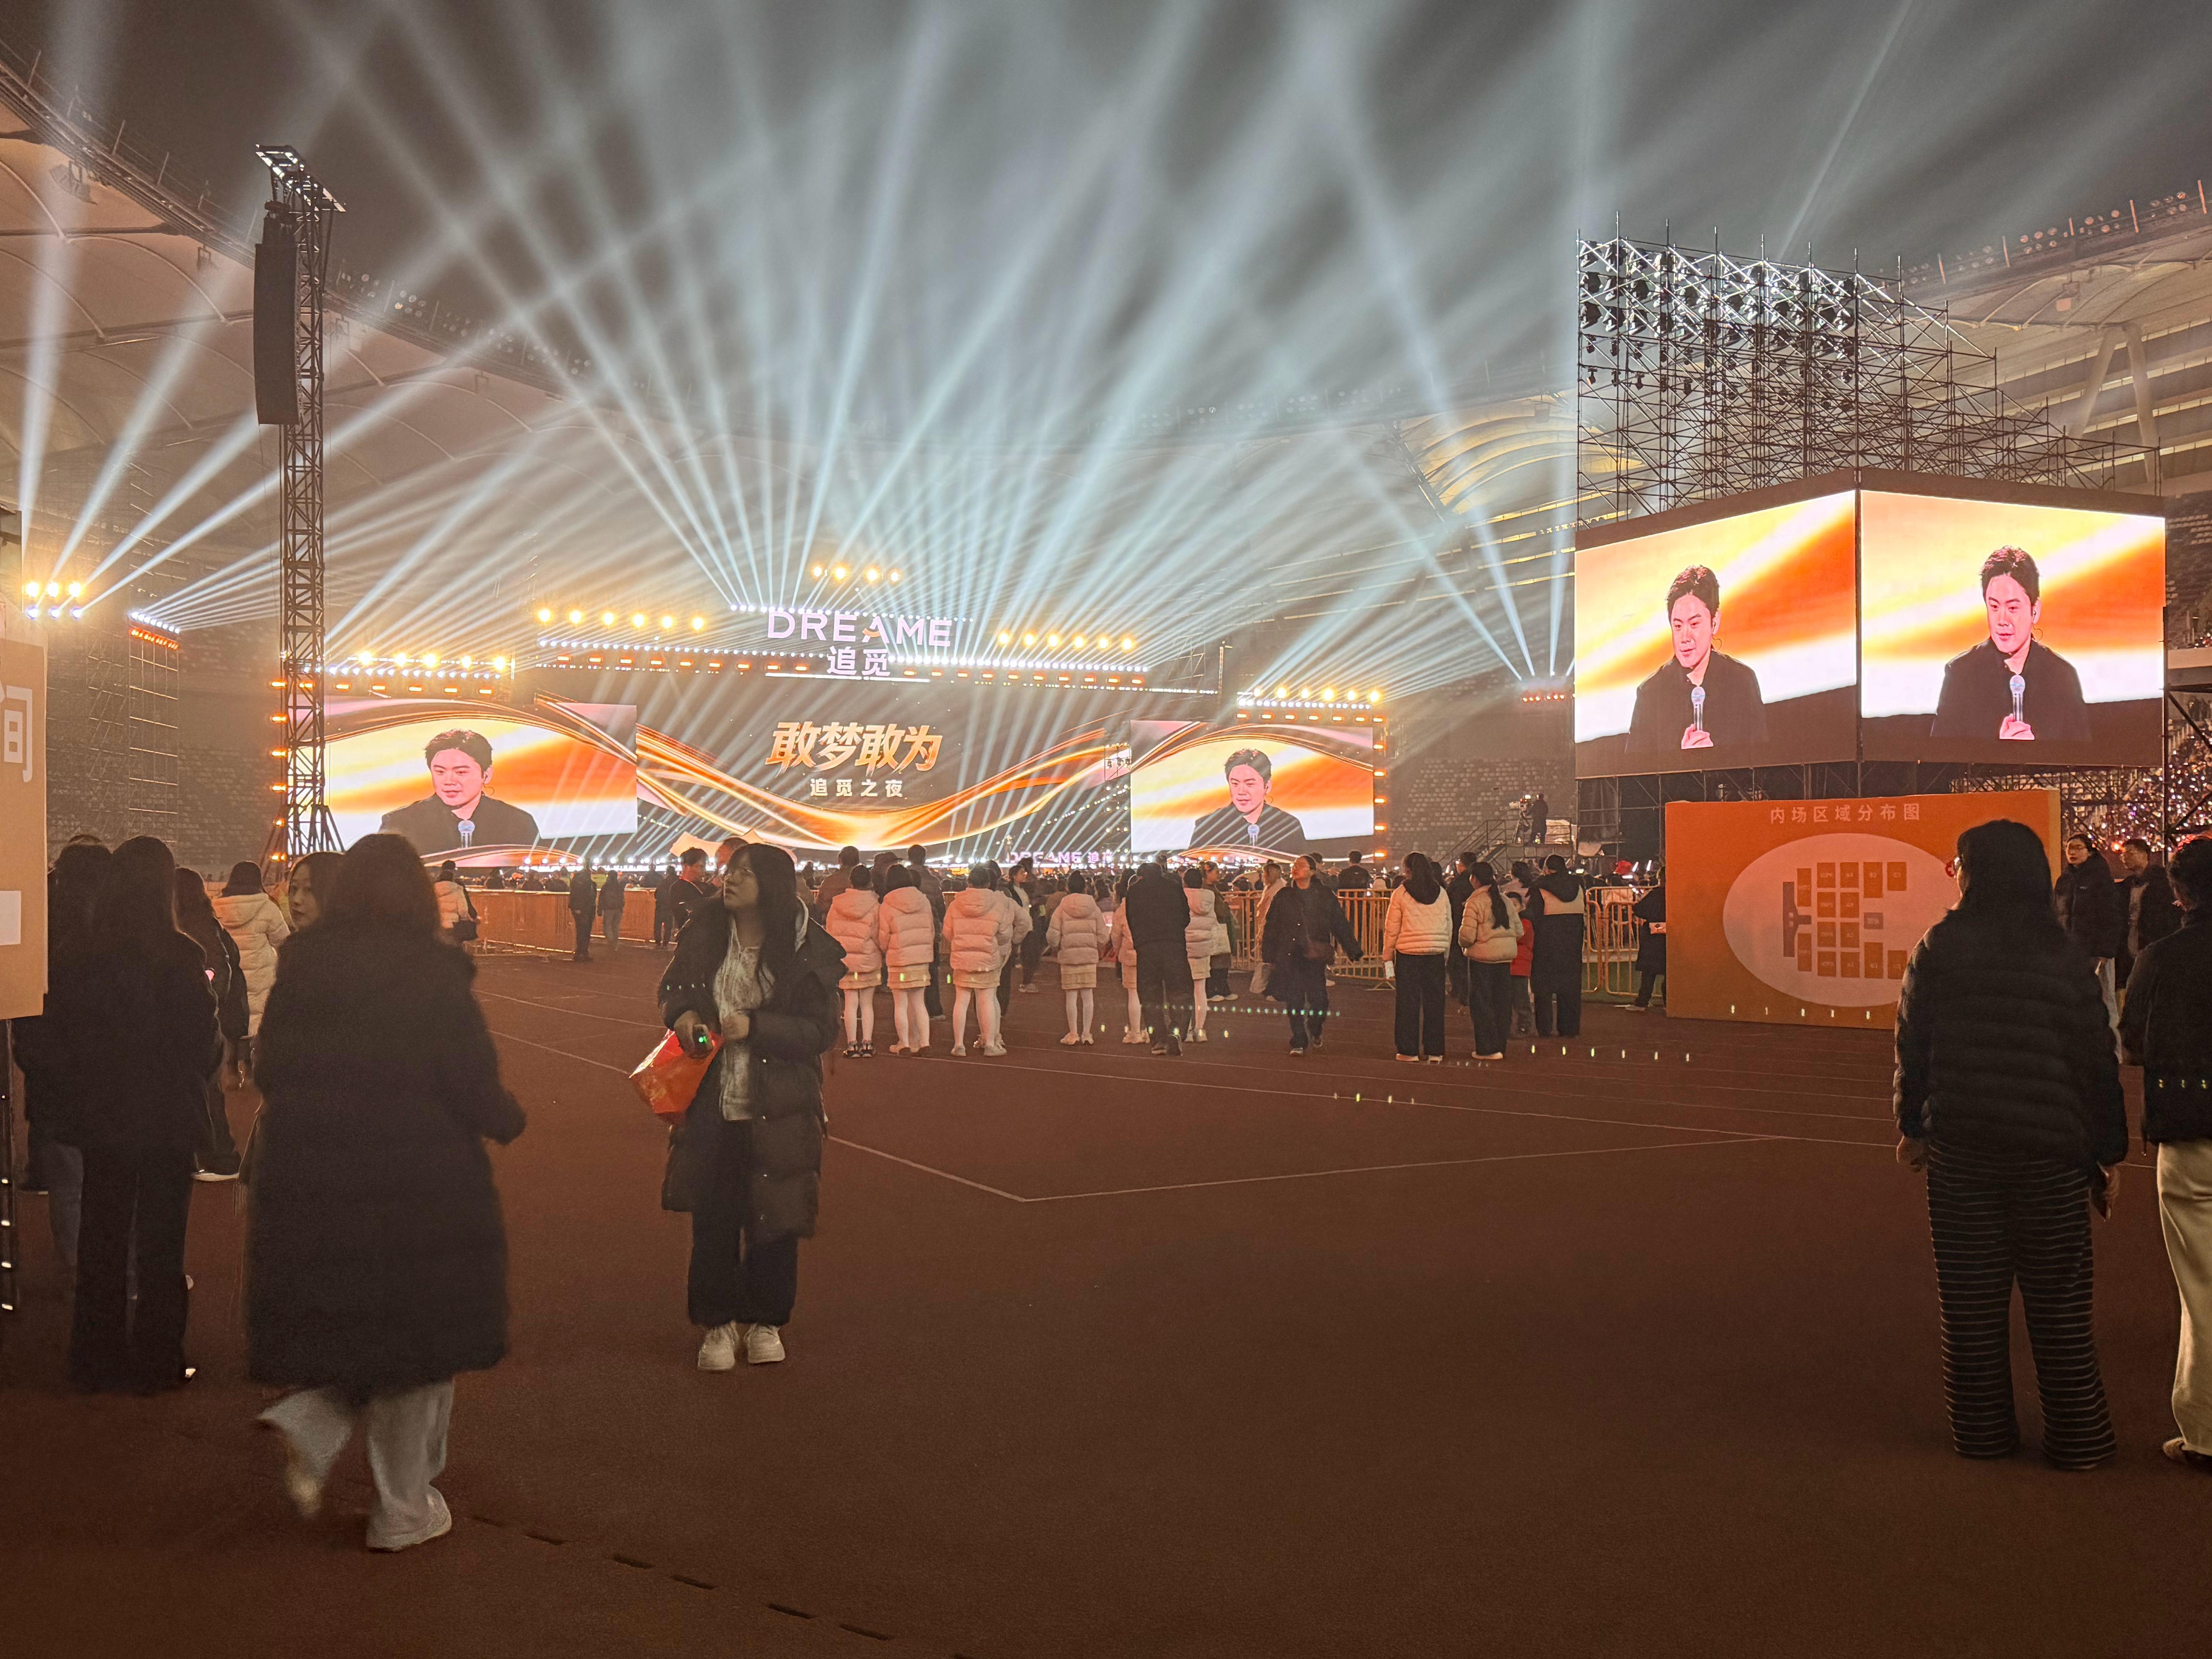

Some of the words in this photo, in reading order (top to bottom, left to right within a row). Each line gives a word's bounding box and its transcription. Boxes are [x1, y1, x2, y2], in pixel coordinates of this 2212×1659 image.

[768, 611, 952, 647] DREAME
[827, 646, 890, 676] 追觅
[765, 721, 943, 778] 敢梦敢为
[810, 778, 903, 798] 追觅之夜
[1771, 803, 1920, 824] 内场区域分布图
